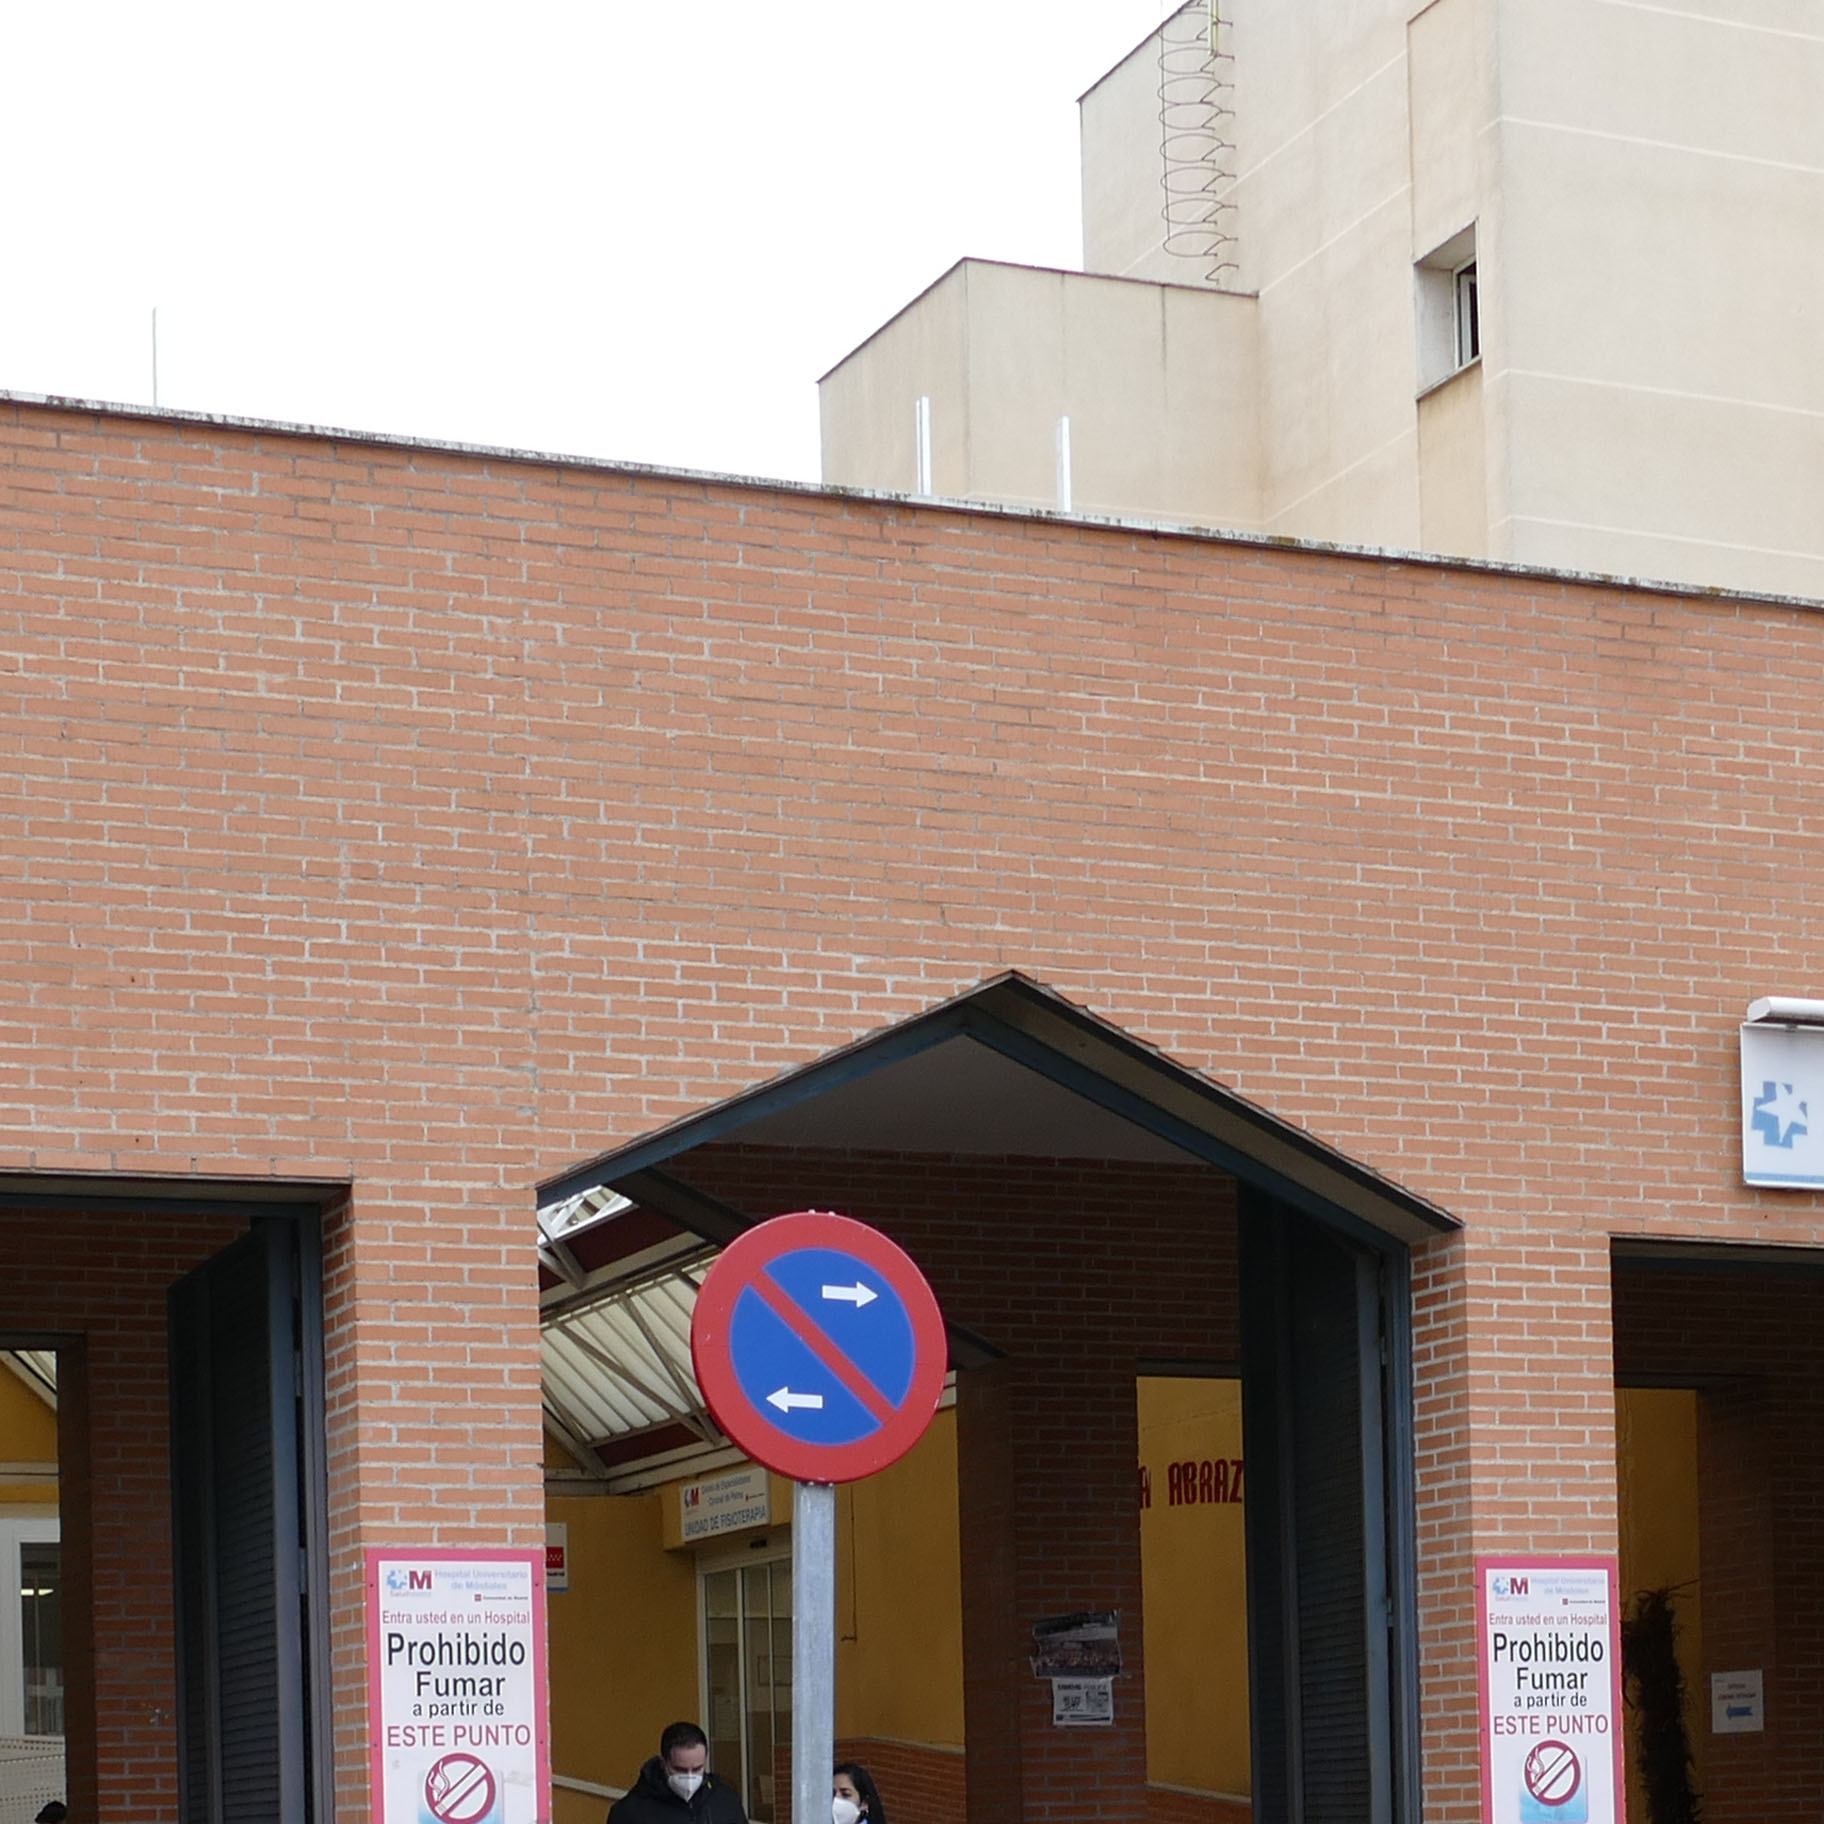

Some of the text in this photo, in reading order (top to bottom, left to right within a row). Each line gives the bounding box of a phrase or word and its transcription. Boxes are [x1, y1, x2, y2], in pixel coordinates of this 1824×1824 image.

[710, 1515, 720, 1530] DE
[382, 1611, 530, 1626] Entra usted en un Hospital
[1489, 1613, 1607, 1627] Entra usted en un Hospital
[388, 1632, 525, 1666] Prohibido
[1493, 1632, 1604, 1662] Prohibido
[416, 1671, 506, 1697] Fumar
[1517, 1667, 1588, 1690] Fumar
[412, 1699, 504, 1718] a partir de
[1514, 1692, 1587, 1710] a partir de
[388, 1724, 530, 1746] ESTE PUNTO
[1494, 1714, 1608, 1735] ESTE PUNTO
